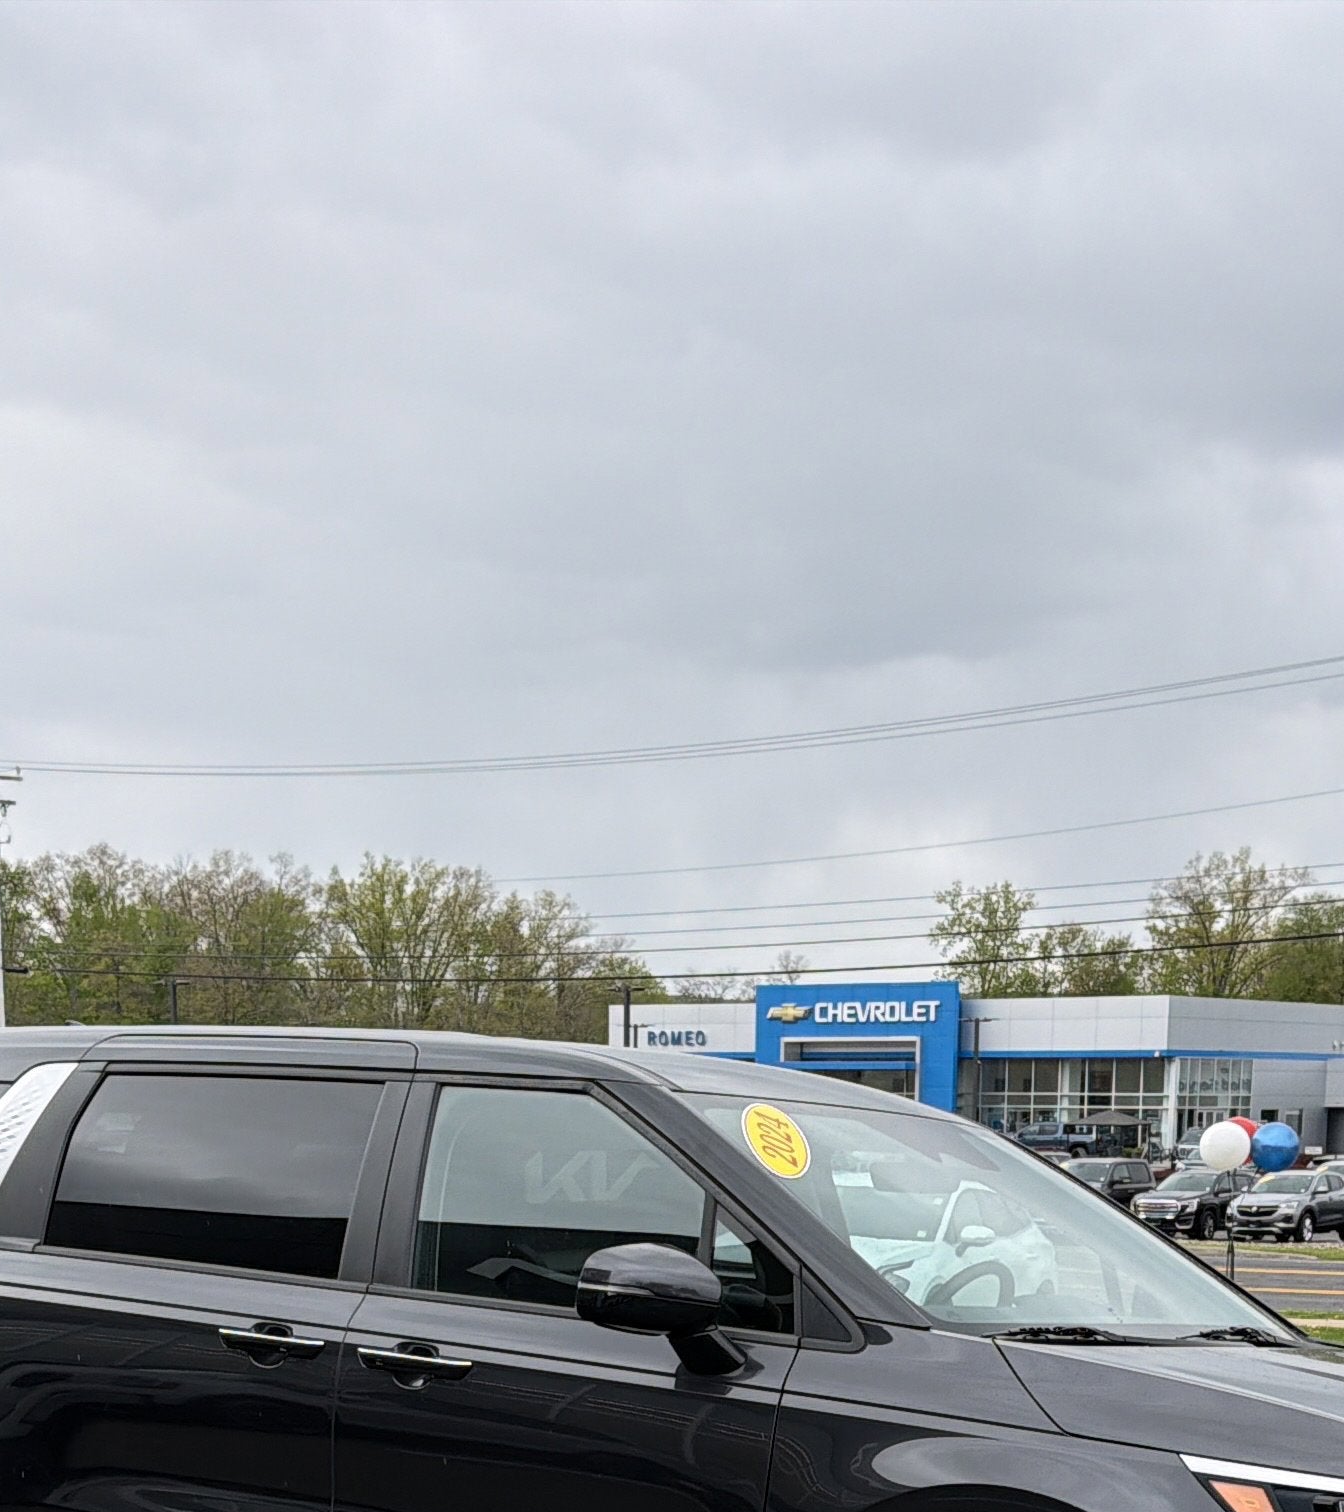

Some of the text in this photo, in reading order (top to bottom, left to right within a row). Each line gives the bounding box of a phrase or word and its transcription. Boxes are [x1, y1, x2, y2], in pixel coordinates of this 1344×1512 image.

[813, 1000, 941, 1024] CHEVROLET
[647, 1029, 707, 1047] ROMEO
[753, 1109, 799, 1169] 2024
